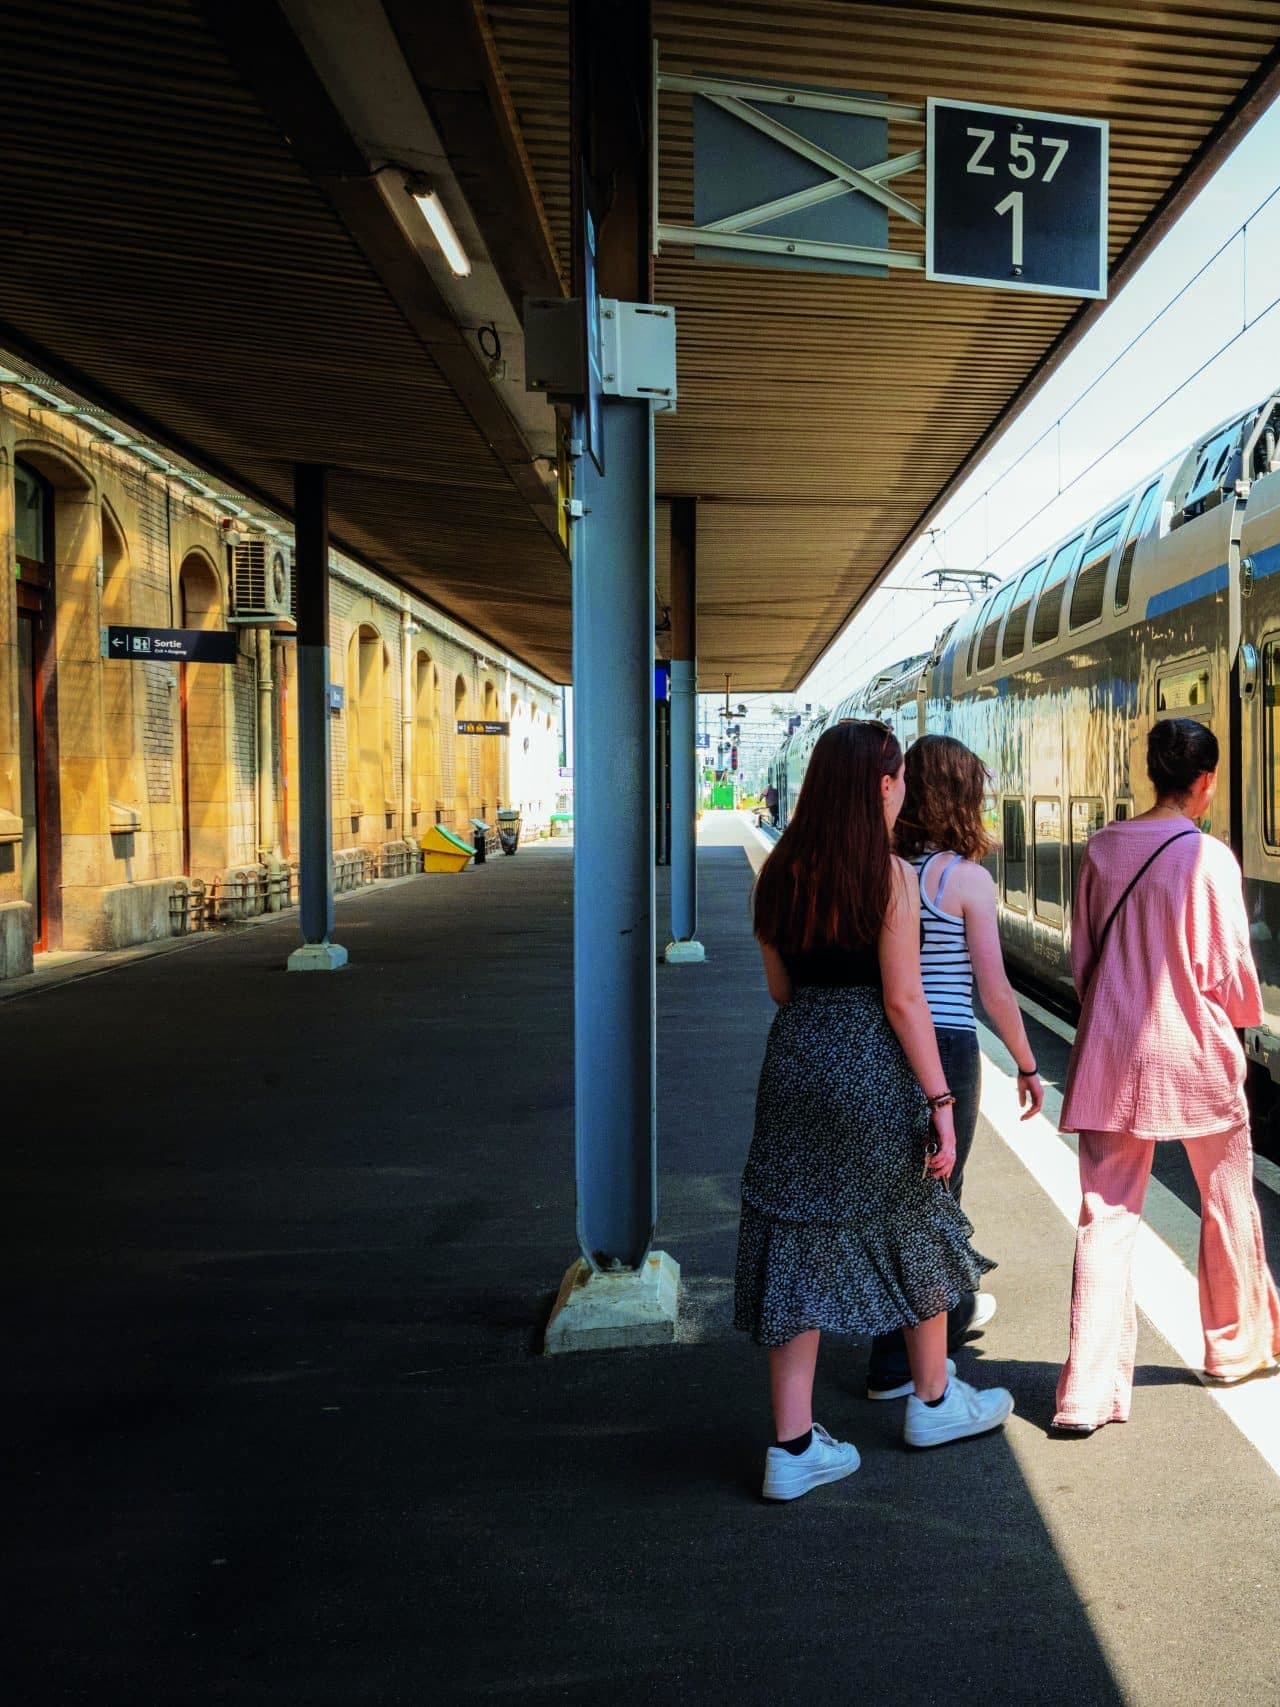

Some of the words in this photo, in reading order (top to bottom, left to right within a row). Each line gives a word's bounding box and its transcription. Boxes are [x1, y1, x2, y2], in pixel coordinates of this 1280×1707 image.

[966, 127, 995, 176] Z
[1008, 132, 1069, 183] 57
[994, 191, 1024, 266] 1
[154, 639, 182, 648] Sortie
